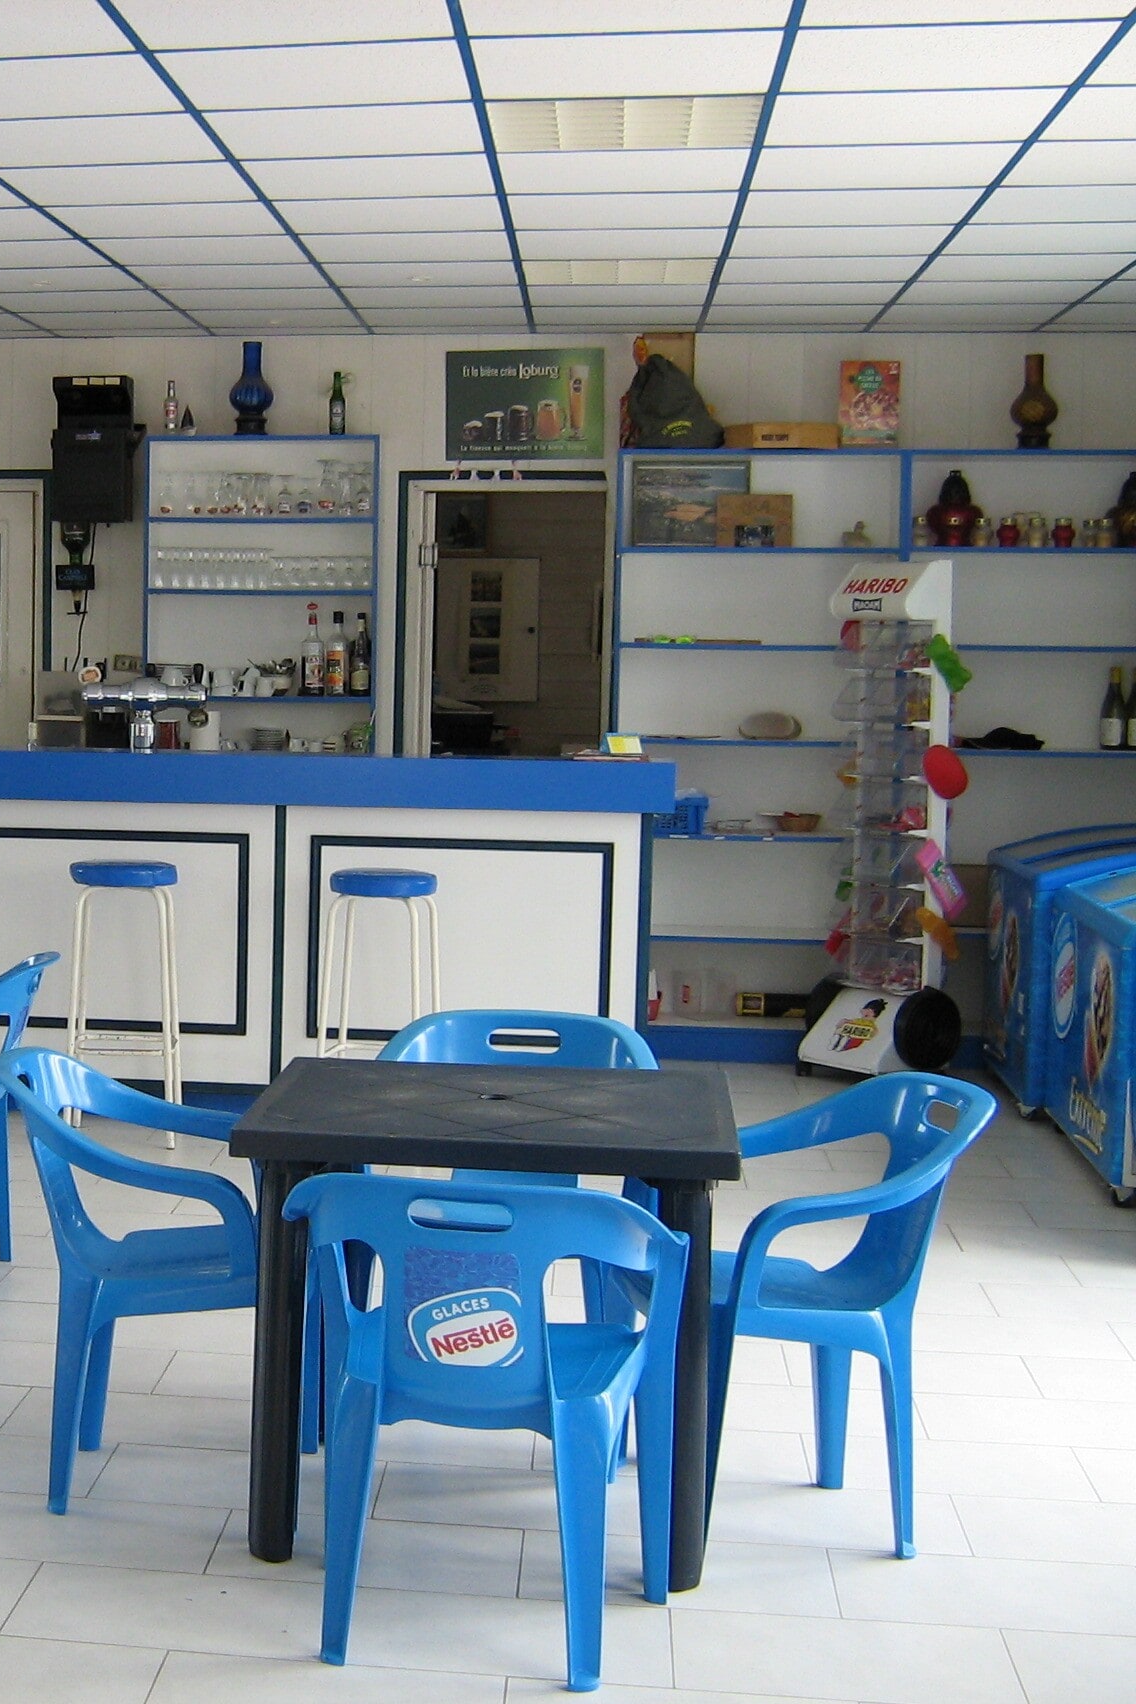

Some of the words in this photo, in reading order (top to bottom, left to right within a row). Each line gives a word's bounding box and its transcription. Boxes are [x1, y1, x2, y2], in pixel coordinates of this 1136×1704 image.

[519, 363, 559, 379] Loburg
[843, 578, 907, 594] HARIBO
[841, 1024, 872, 1037] HARIBO
[431, 1297, 490, 1321] GLACES
[430, 1317, 515, 1358] Nestlé
